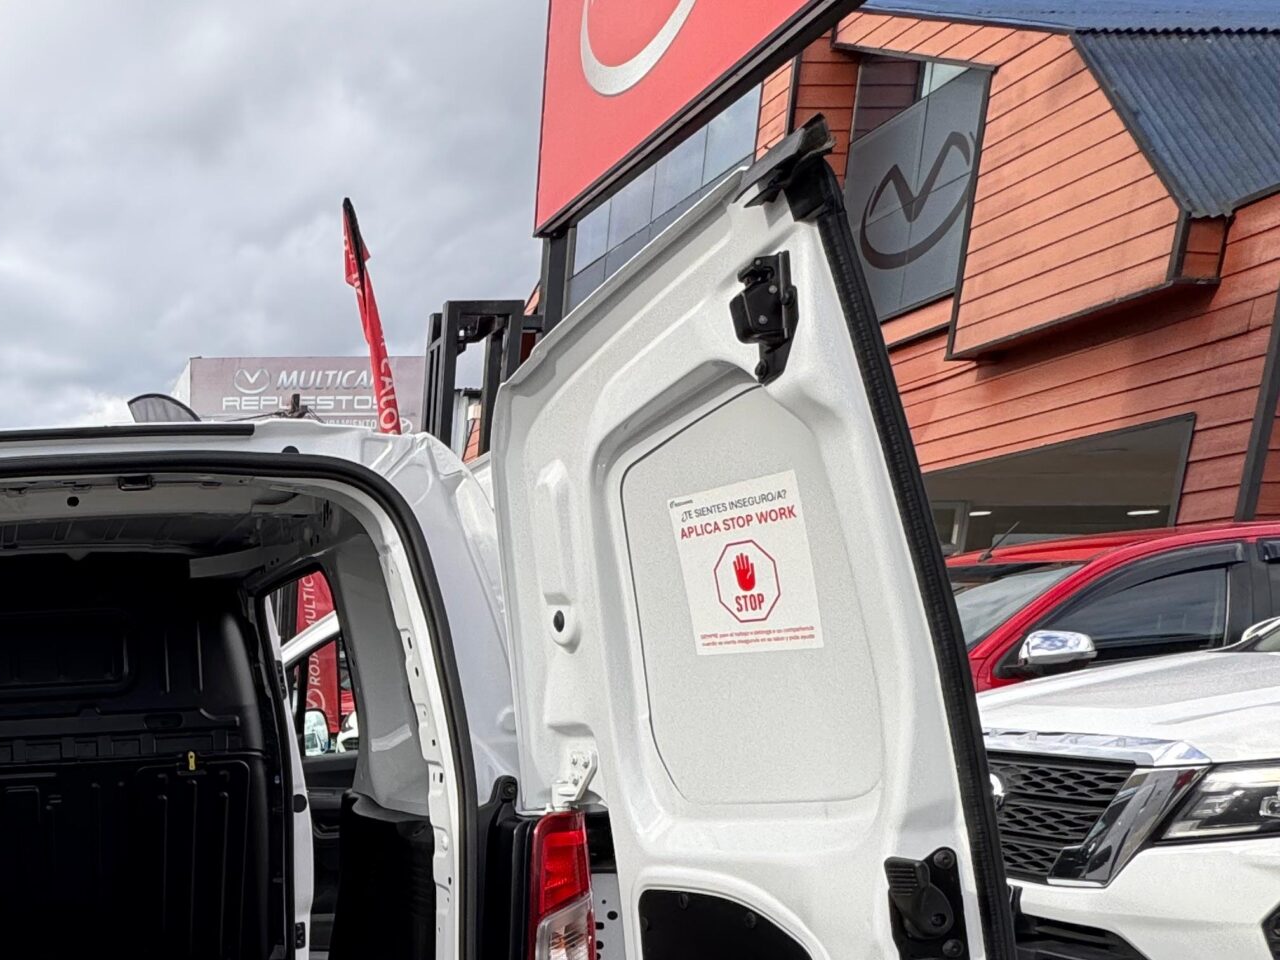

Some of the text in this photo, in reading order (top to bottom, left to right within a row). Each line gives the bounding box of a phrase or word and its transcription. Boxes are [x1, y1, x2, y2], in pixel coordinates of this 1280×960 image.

[276, 370, 373, 388] MULTICA
[681, 510, 693, 522] ¿TE
[694, 502, 728, 518] SIENTES
[729, 489, 787, 510] INSEGURO/A?
[681, 504, 797, 539] APLICA STOP WORK
[735, 593, 765, 613] STOP
